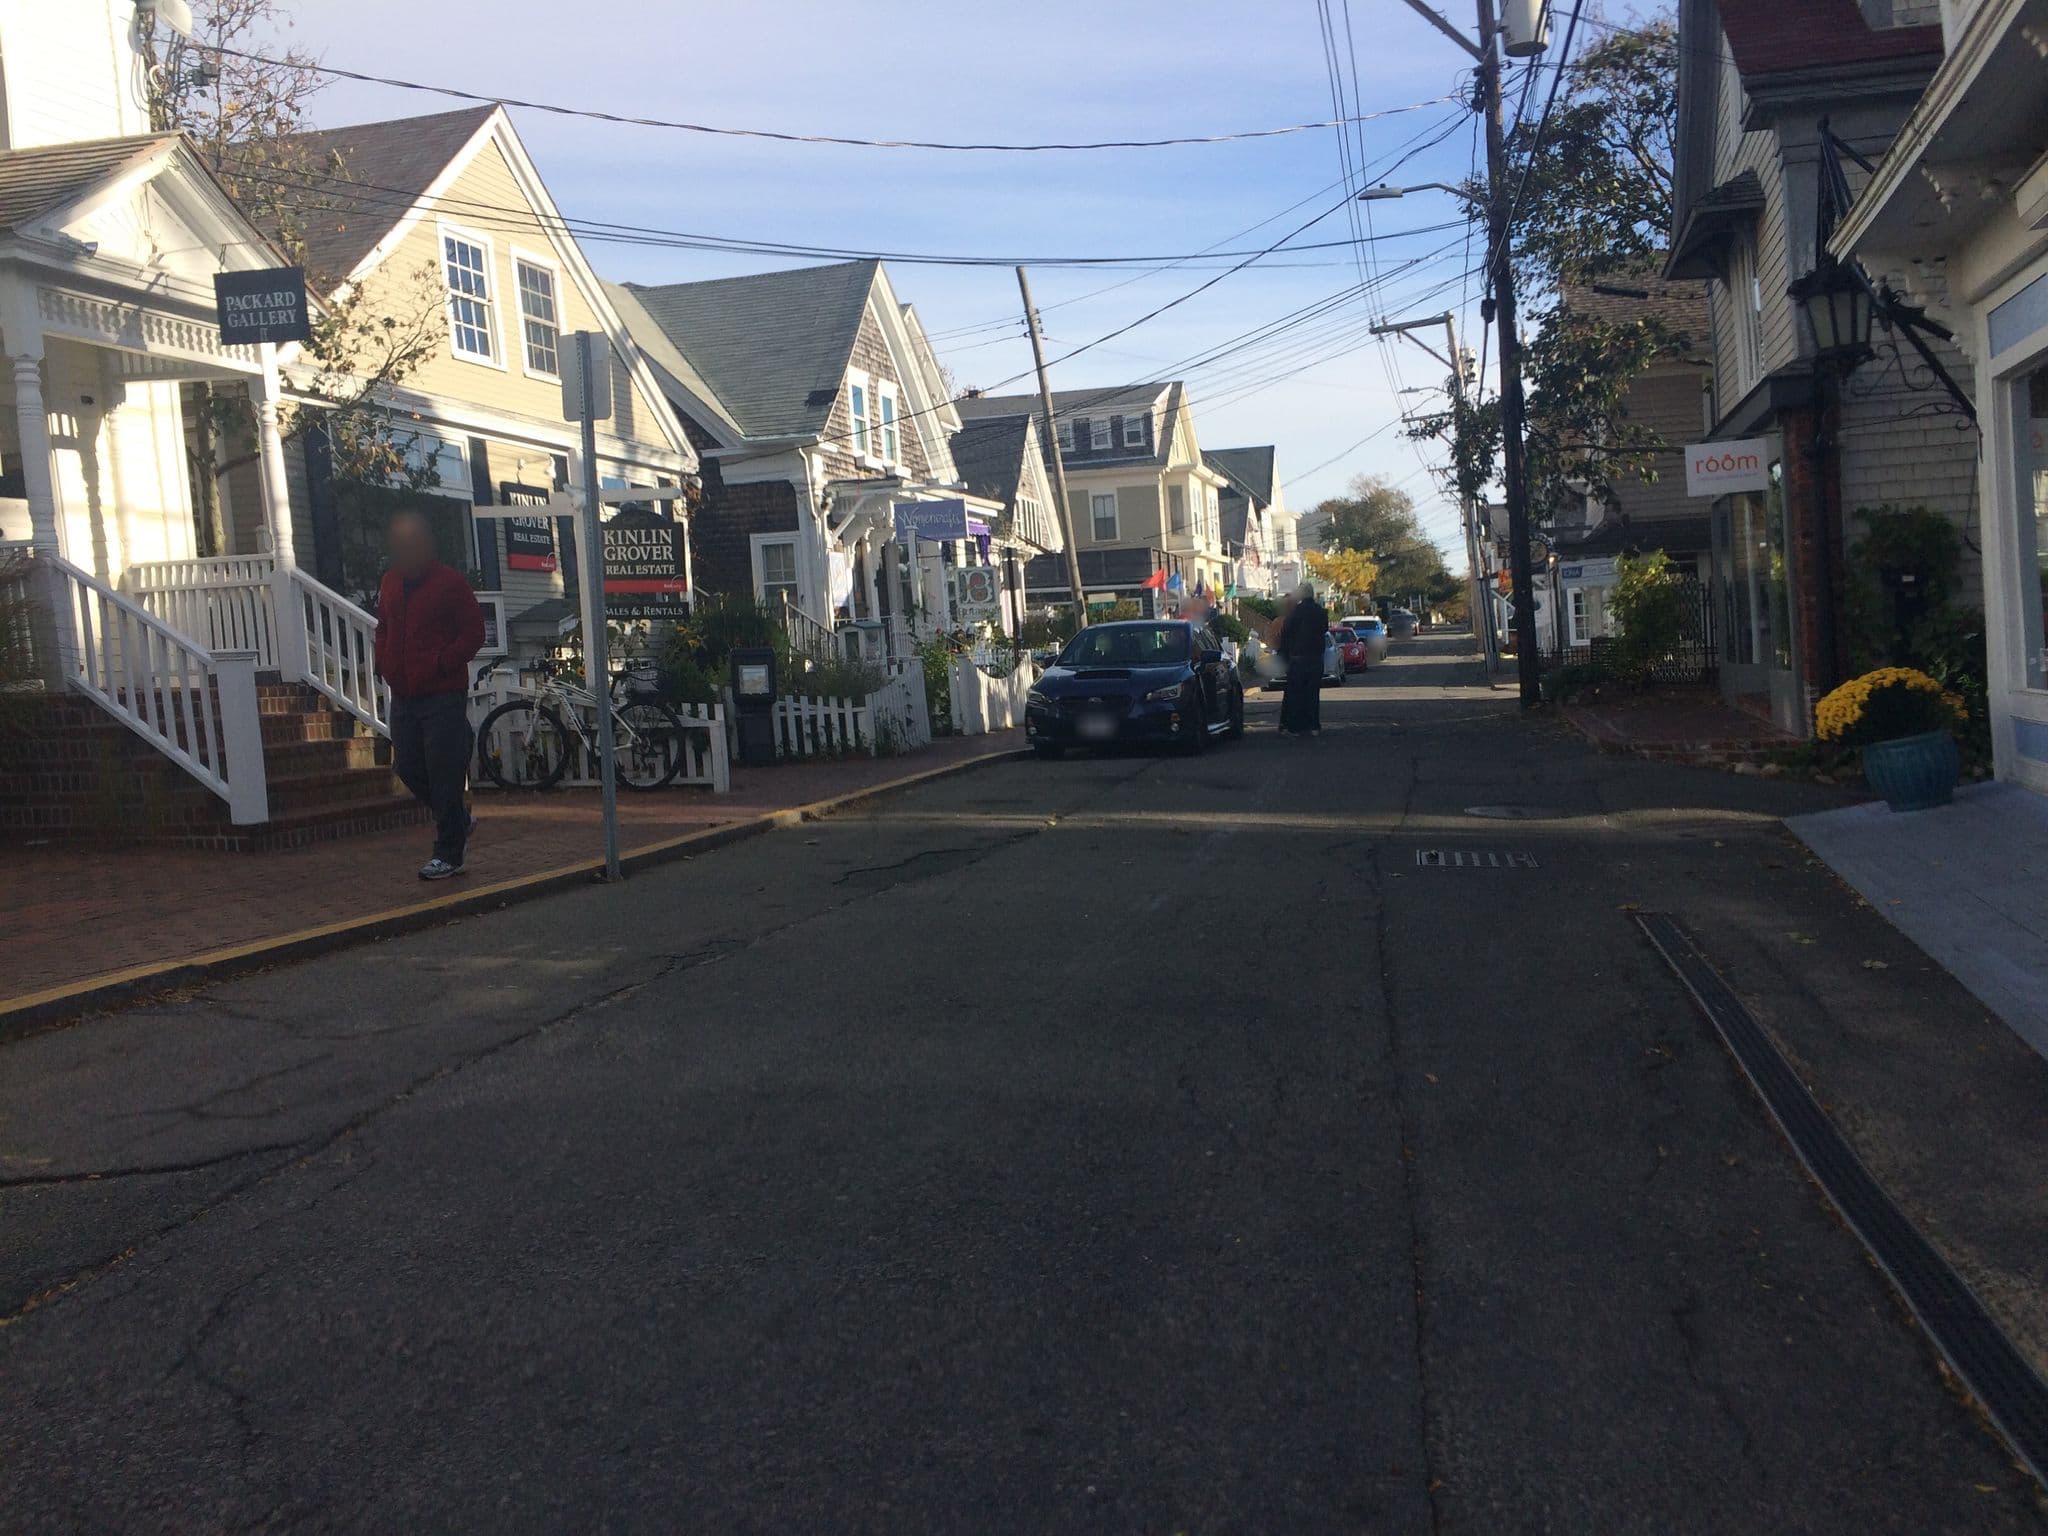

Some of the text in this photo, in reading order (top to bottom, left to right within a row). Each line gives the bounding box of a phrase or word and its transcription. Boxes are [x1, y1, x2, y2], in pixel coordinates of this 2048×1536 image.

[225, 291, 296, 311] PACKARD
[227, 309, 297, 327] GALLERY
[513, 532, 551, 544] REAL ESTATE
[603, 528, 672, 545] KINLIN
[603, 545, 674, 561] GROVER
[606, 564, 676, 575] REAL ESTATE
[631, 606, 641, 616] &
[643, 605, 684, 616] RENTALS
